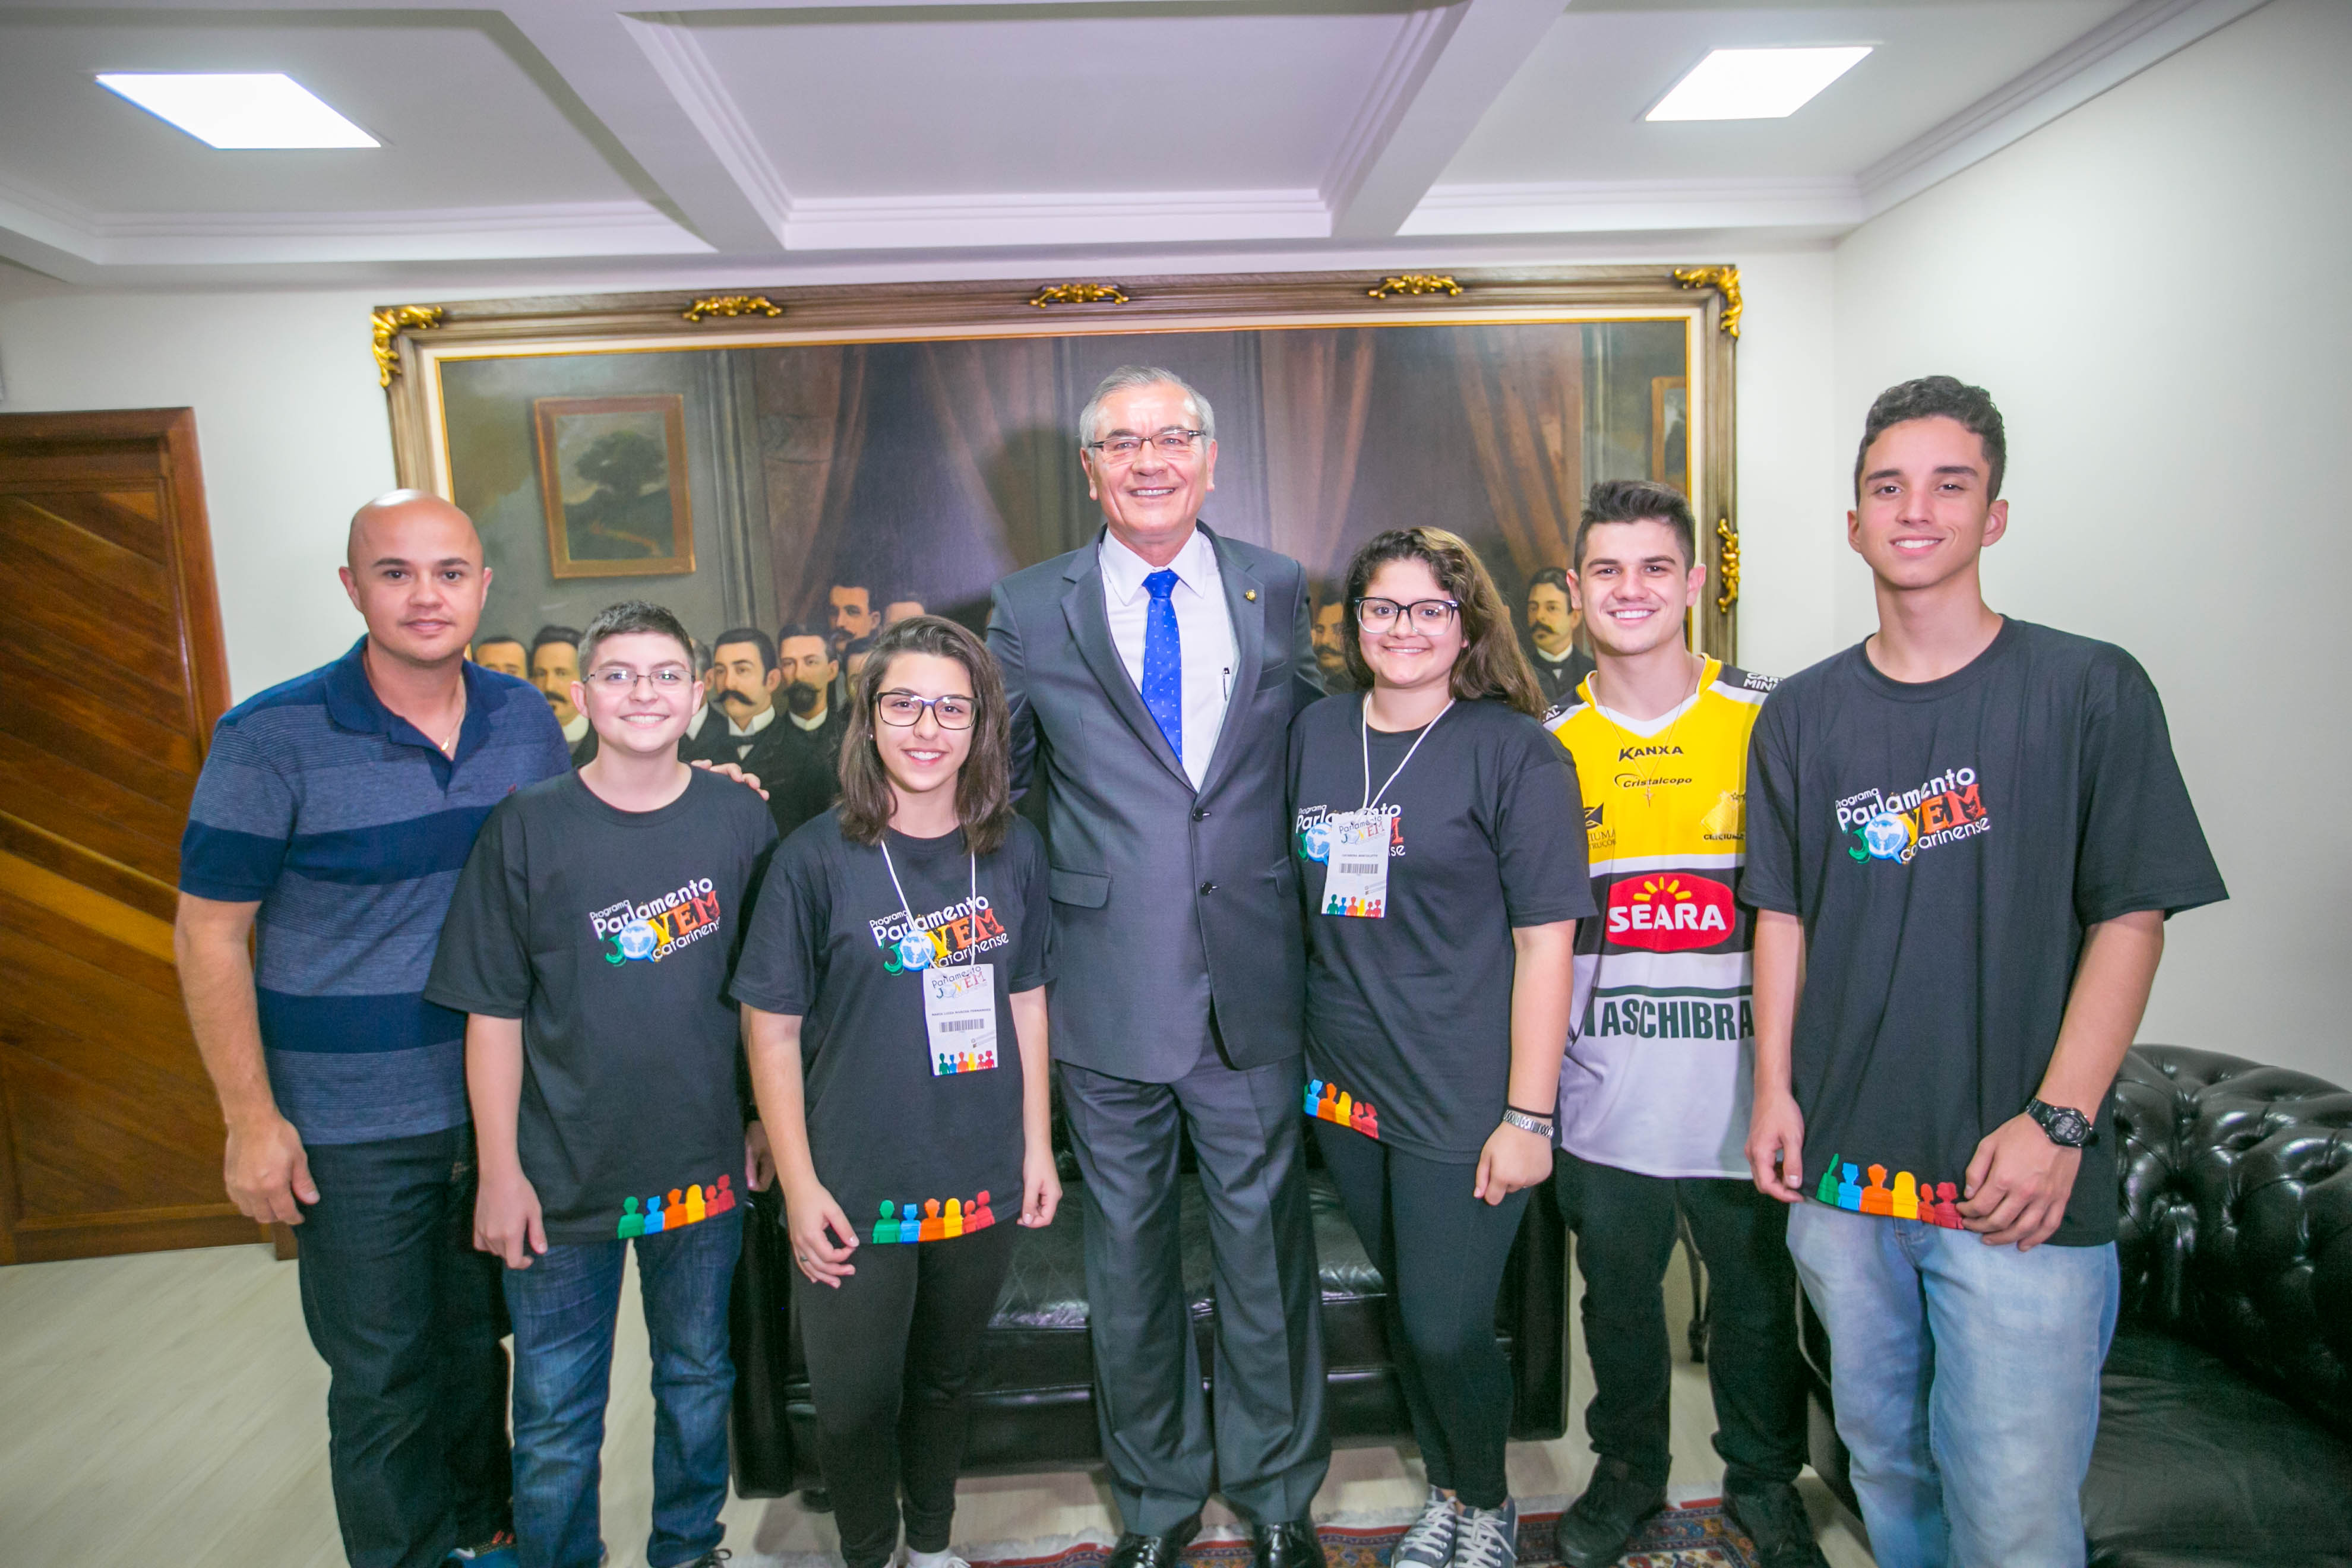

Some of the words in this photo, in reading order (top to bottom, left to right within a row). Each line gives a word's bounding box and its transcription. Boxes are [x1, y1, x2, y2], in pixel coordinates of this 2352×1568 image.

[1618, 745, 1684, 762] KANXA
[1623, 776, 1692, 788] Cristalcopo
[1835, 788, 1879, 809] Programa
[1836, 767, 1975, 832] Parlamento
[1900, 817, 1990, 861] caarinense
[590, 899, 630, 921] Programa
[592, 878, 713, 940] Parlamento
[869, 910, 908, 928] Programa
[871, 896, 989, 947] Parlamento
[1608, 903, 1727, 933] SEARA
[931, 932, 1009, 969] atarinense
[1584, 987, 1755, 1041] TASCHIBRA
